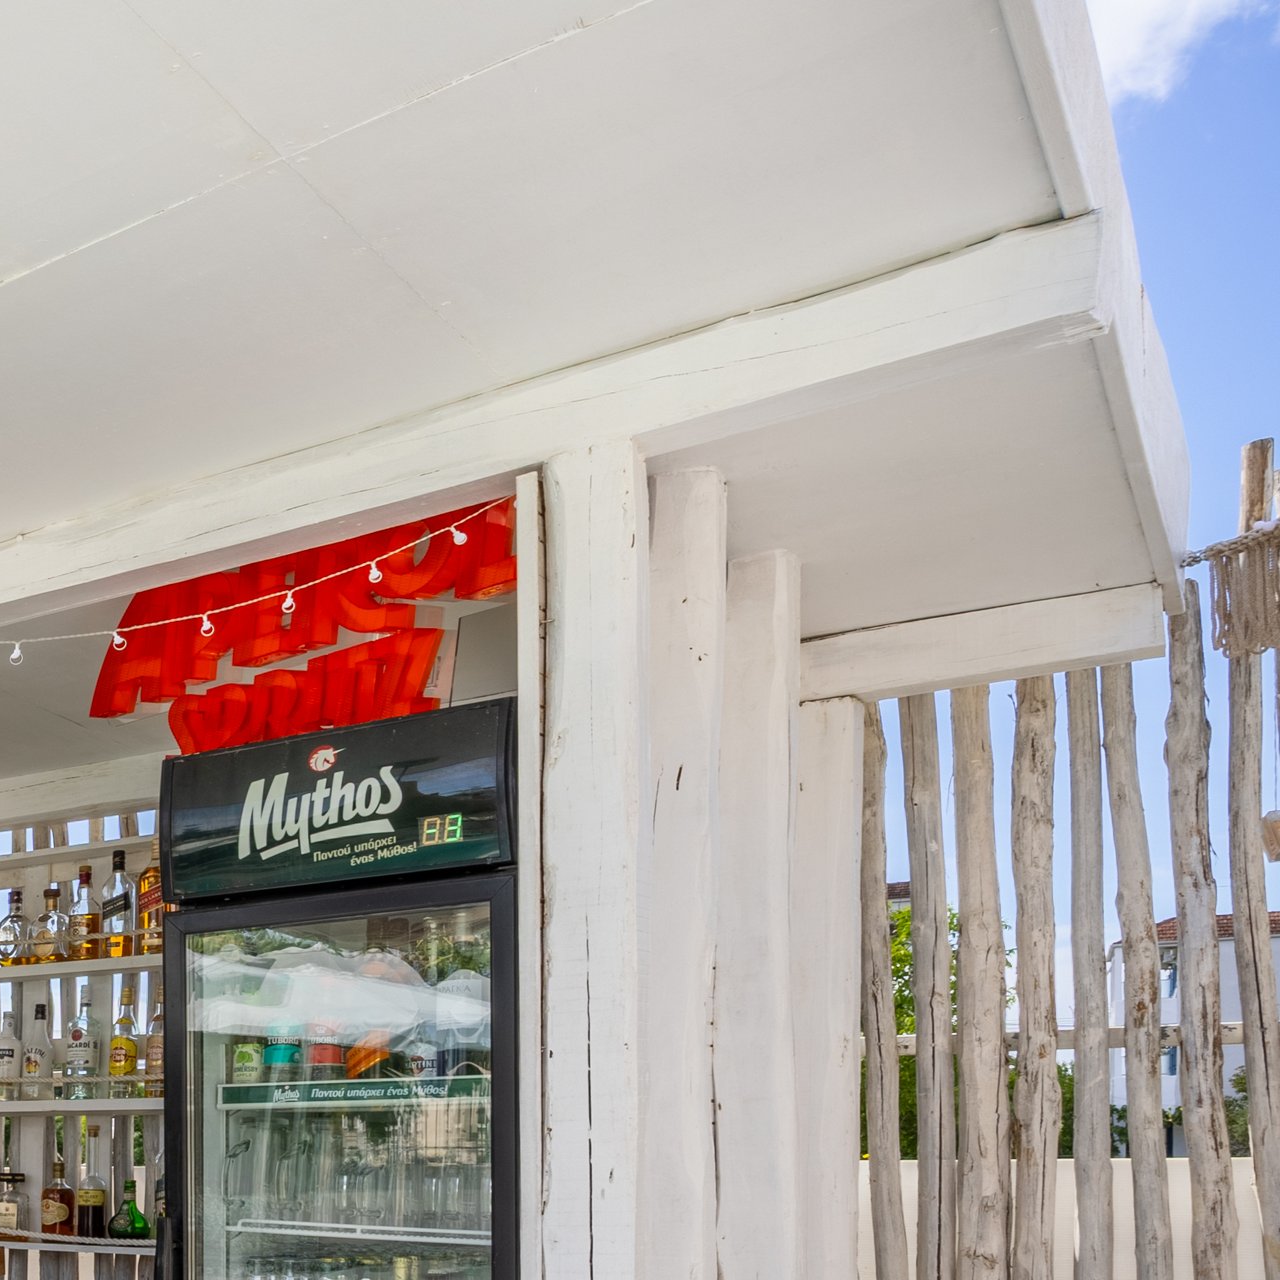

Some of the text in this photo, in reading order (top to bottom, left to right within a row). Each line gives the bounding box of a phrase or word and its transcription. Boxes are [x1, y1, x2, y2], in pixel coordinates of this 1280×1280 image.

[237, 765, 404, 860] Mythos
[313, 835, 397, 863] Παντού υπάρχει
[350, 841, 417, 867] ένας Μύθος!
[268, 1036, 299, 1045] TUBORG
[309, 1036, 338, 1045] UBORG
[273, 1087, 300, 1102] Mythos
[311, 1085, 448, 1099] Παντού υπάρχει ένας Μύθος!
